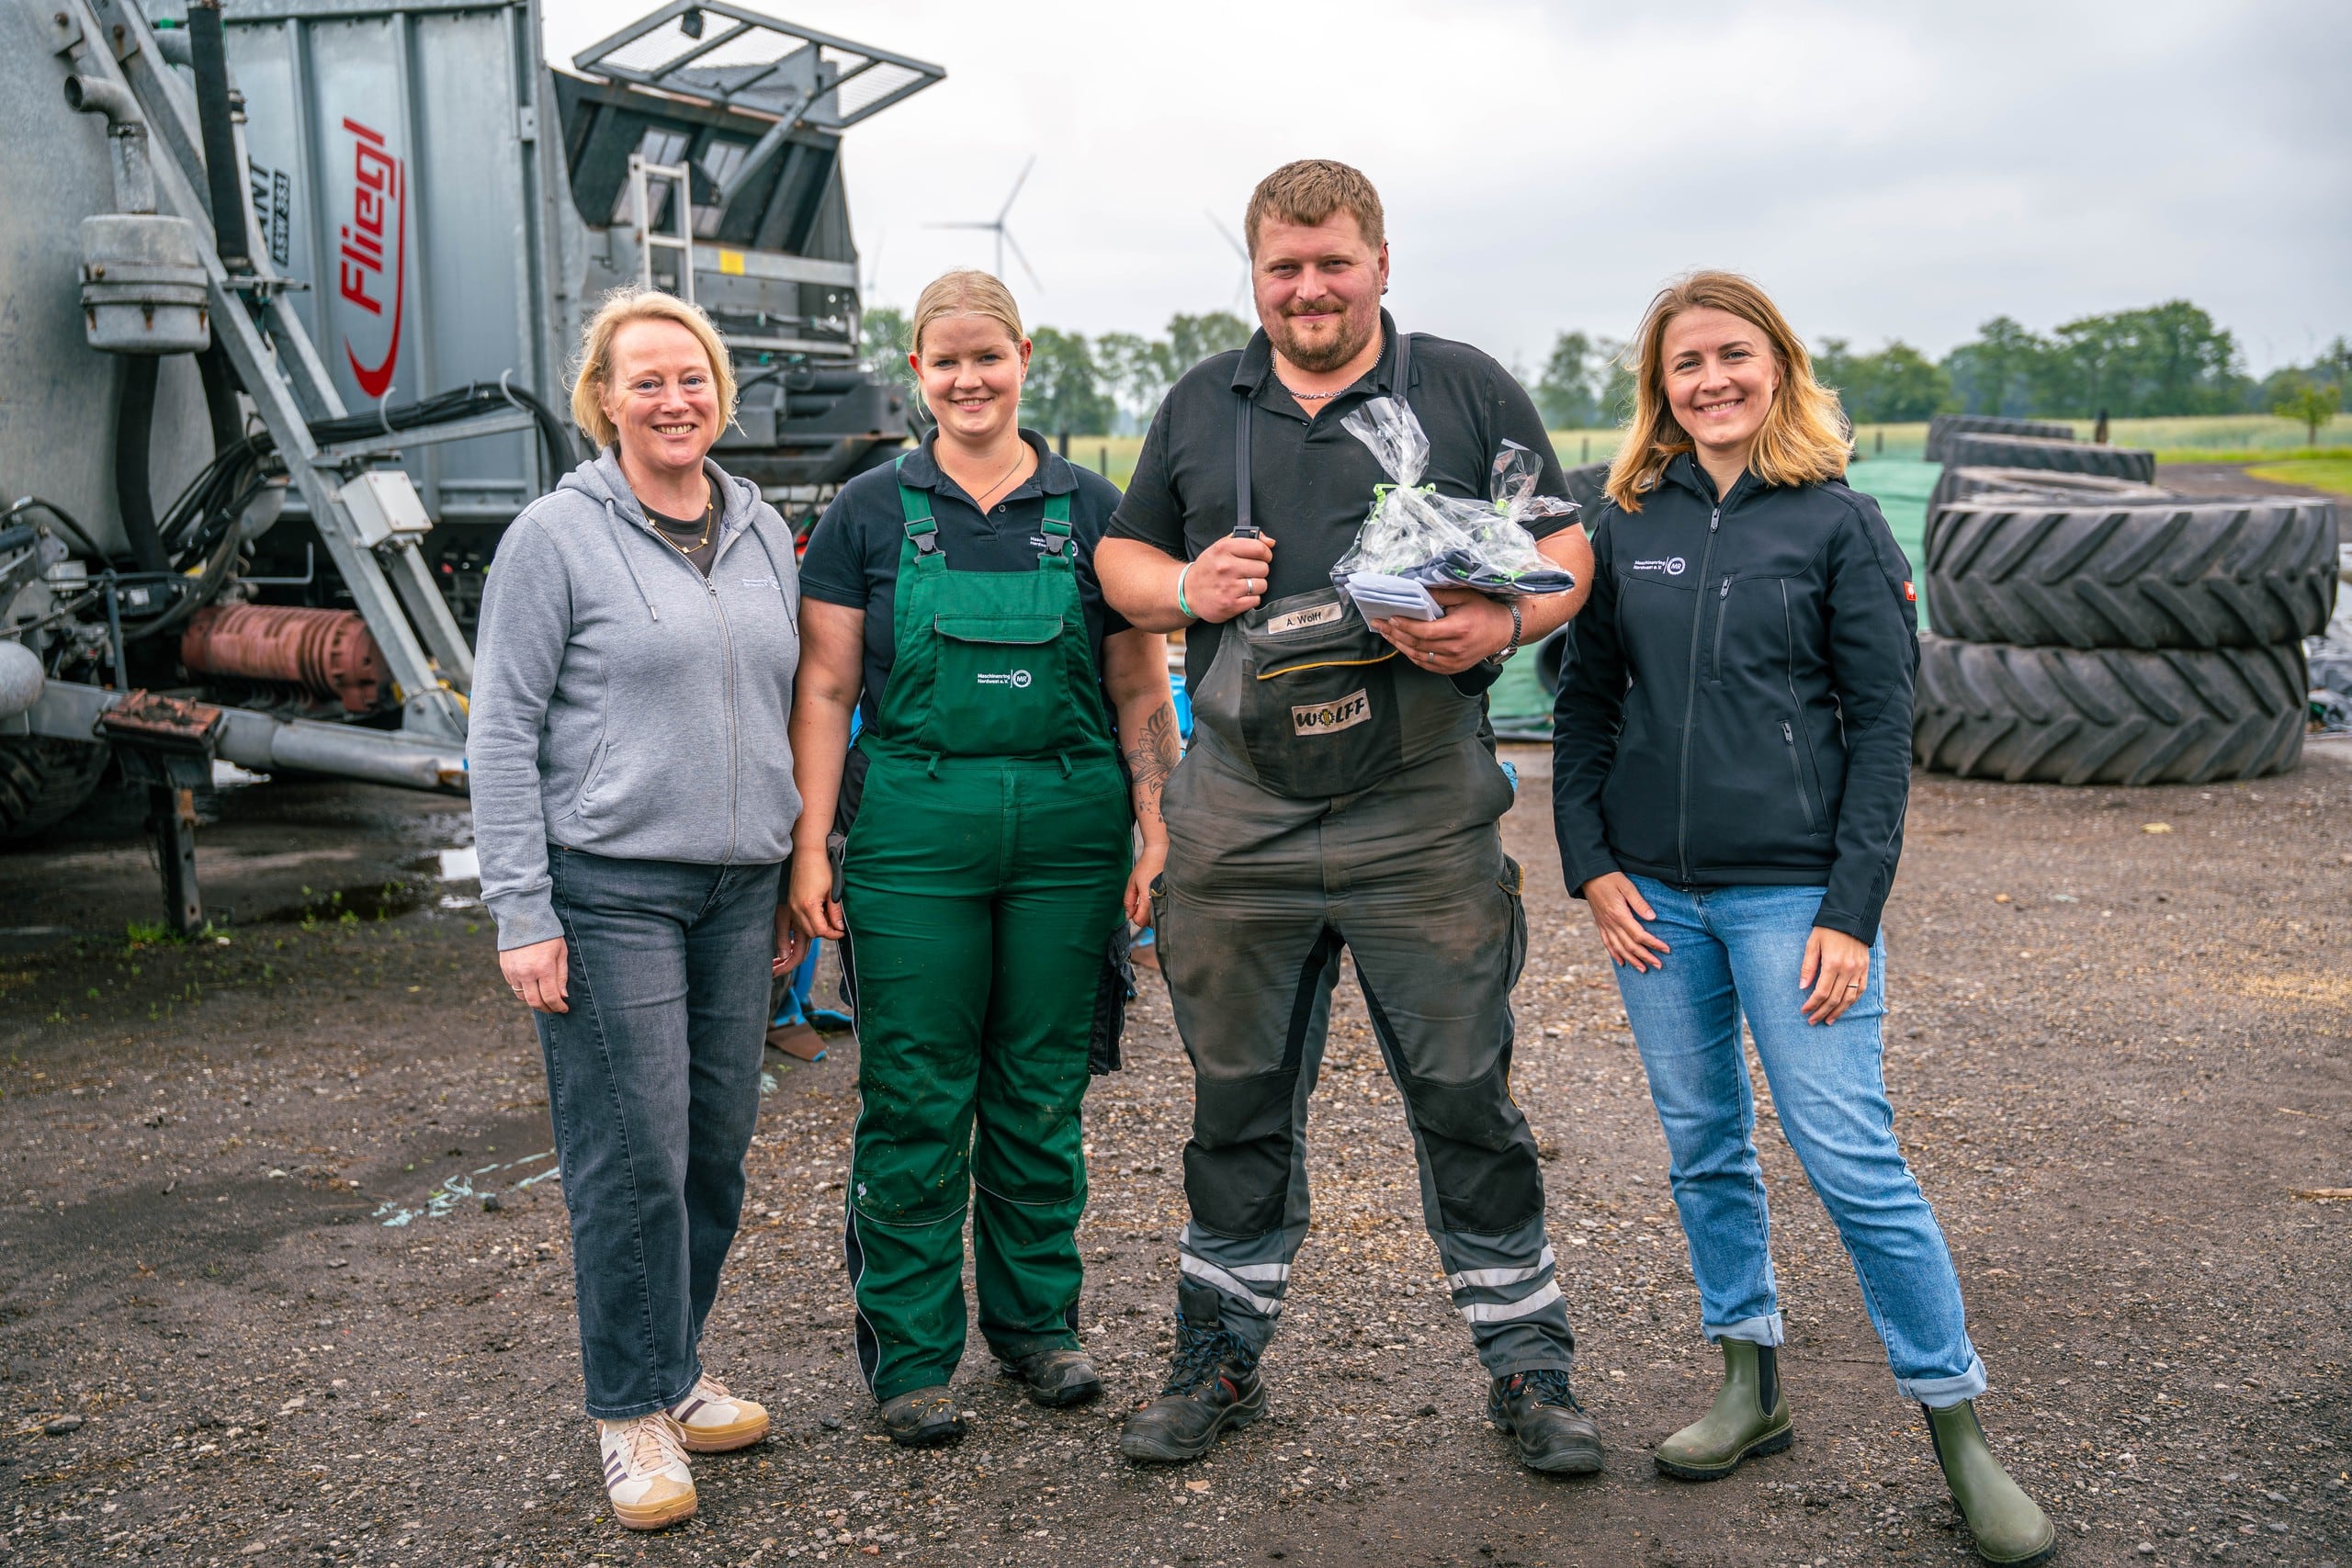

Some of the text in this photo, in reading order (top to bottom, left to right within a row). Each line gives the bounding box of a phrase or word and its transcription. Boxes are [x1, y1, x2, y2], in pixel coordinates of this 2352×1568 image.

[342, 118, 395, 315] Fliegl
[1286, 612, 1322, 627] A. Wolff
